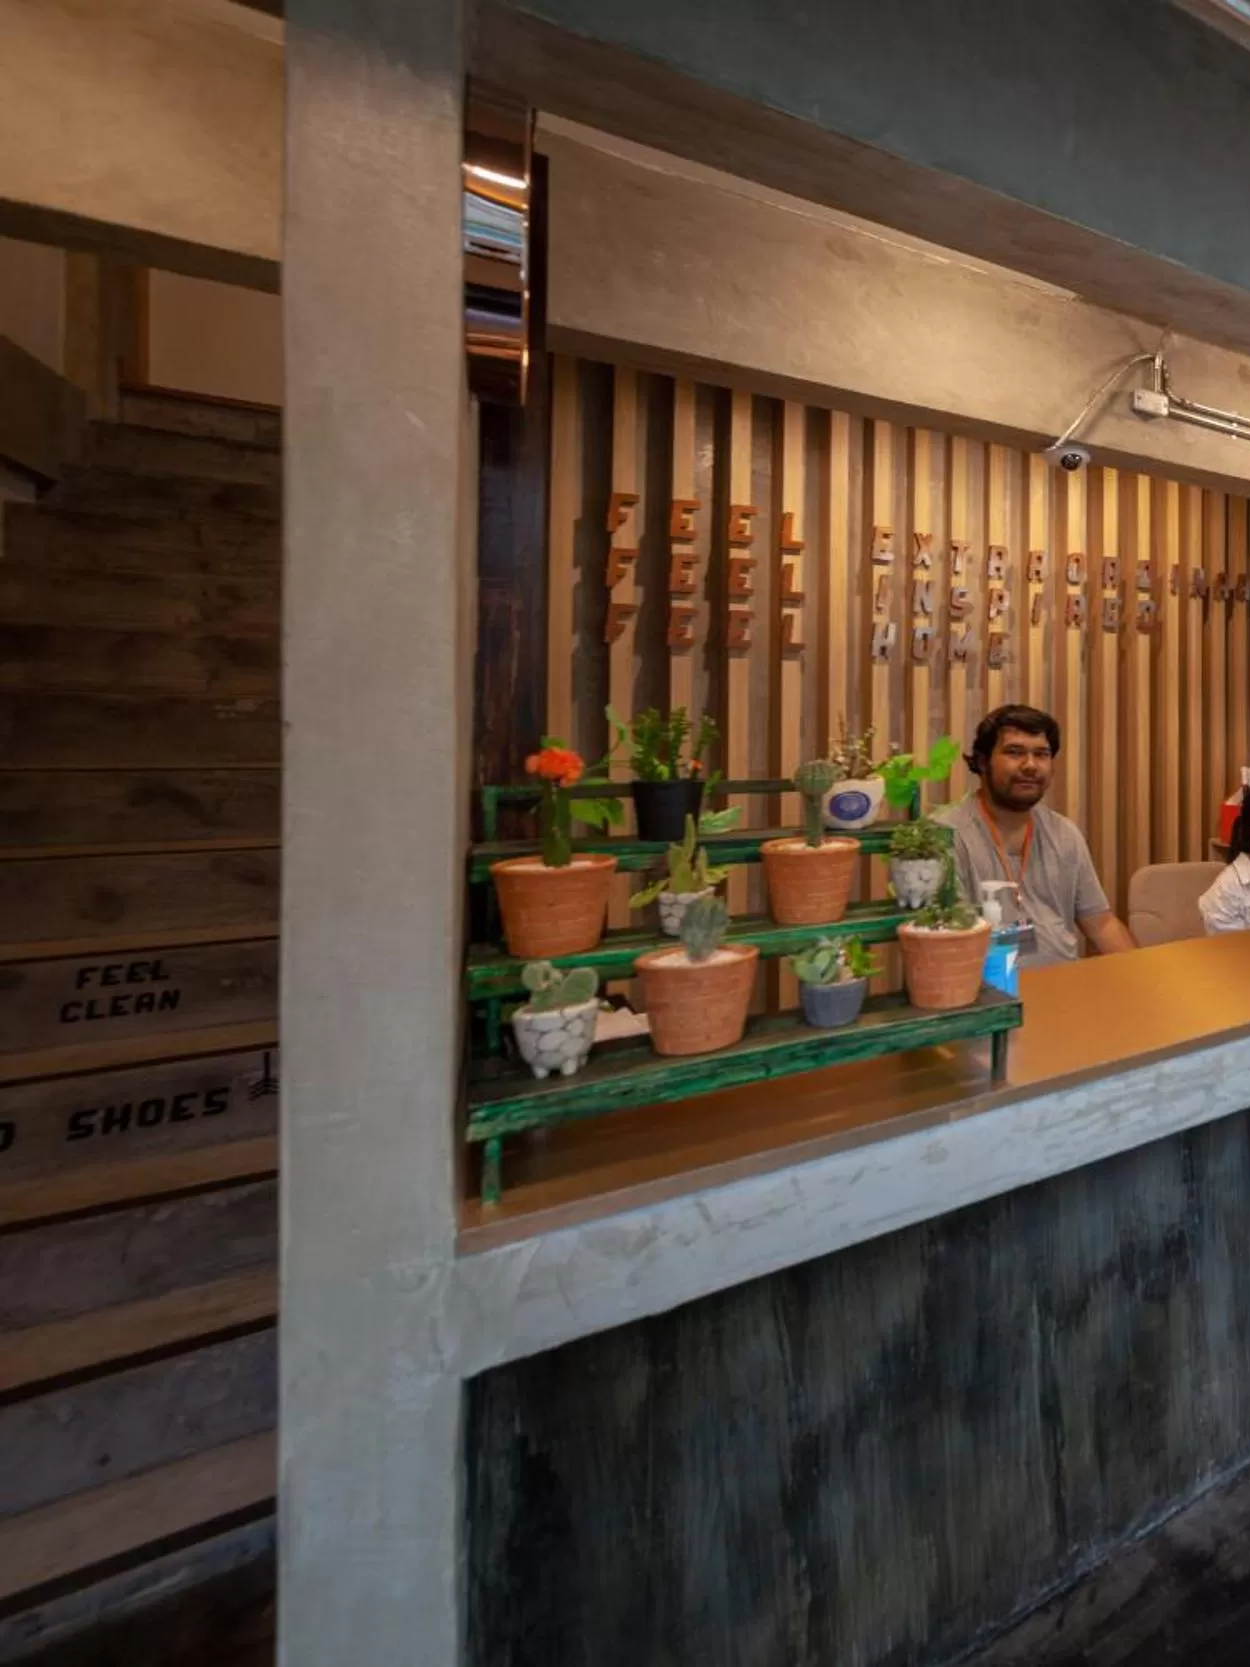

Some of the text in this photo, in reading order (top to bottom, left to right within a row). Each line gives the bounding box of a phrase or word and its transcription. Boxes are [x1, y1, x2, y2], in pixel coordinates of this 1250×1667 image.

[606, 492, 805, 555] FEEL
[605, 547, 805, 605] FEEL
[603, 603, 1016, 670] FEEL HOME
[76, 960, 170, 990] FEEL
[59, 988, 182, 1024] CLEAN
[66, 1086, 231, 1142] SHOES
